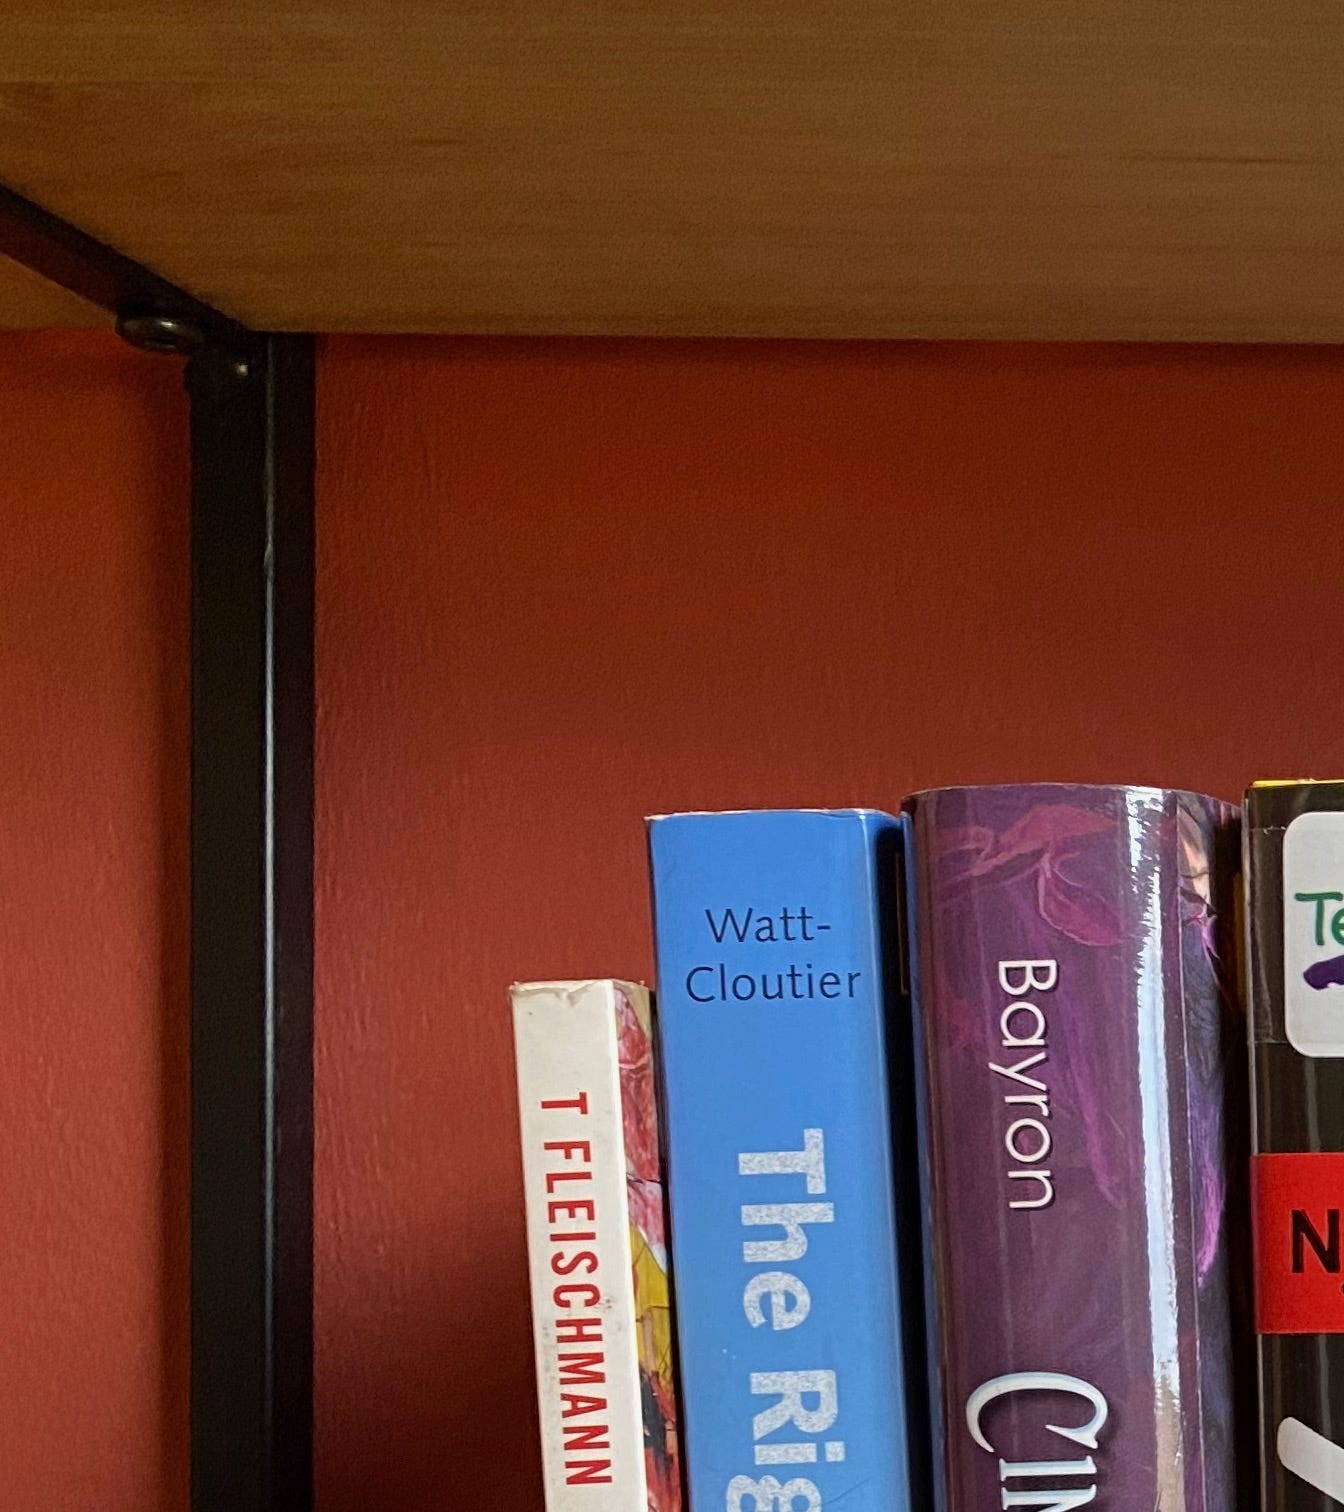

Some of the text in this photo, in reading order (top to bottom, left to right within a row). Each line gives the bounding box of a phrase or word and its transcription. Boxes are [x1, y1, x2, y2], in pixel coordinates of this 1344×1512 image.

[686, 963, 862, 1002] Cloutier
[705, 907, 832, 944] Watt-
[988, 959, 1059, 1211] Bayron
[541, 1092, 613, 1487] T FLEISCHMANN
[738, 1128, 835, 1331] The
